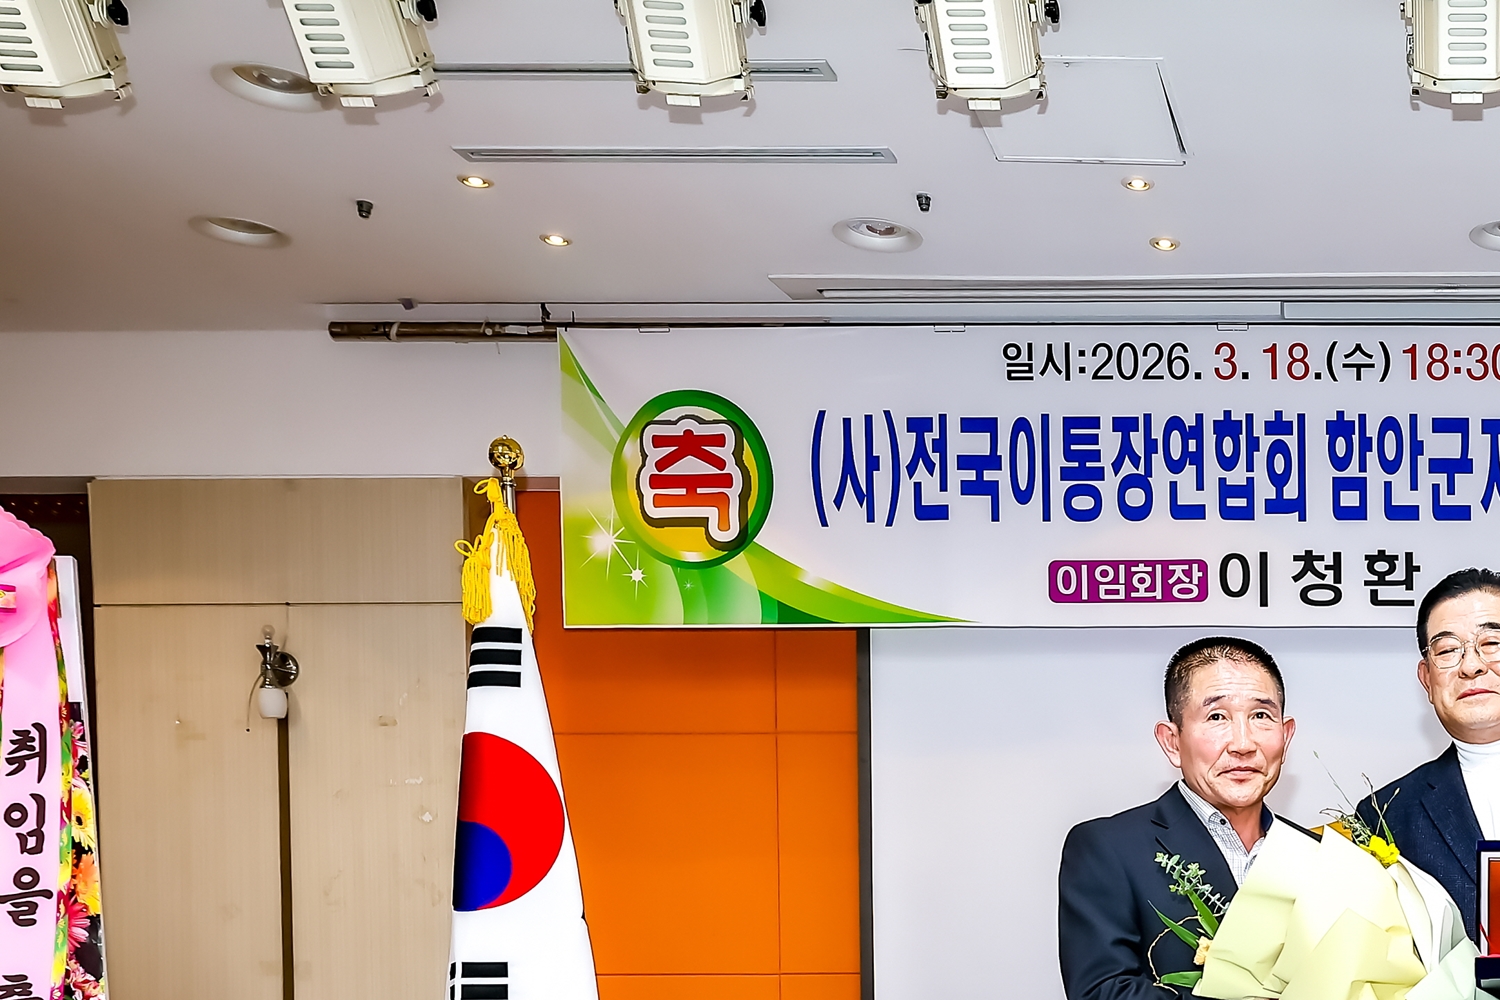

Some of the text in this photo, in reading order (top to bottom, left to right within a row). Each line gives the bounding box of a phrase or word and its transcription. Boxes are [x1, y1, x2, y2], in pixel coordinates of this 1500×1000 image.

[1214, 343, 1249, 380] 3.
[645, 424, 737, 536] 축
[811, 410, 1306, 527] (사)전국이통장연합회
[1056, 563, 1203, 601] 이임회장
[0, 722, 53, 927] 취임을
